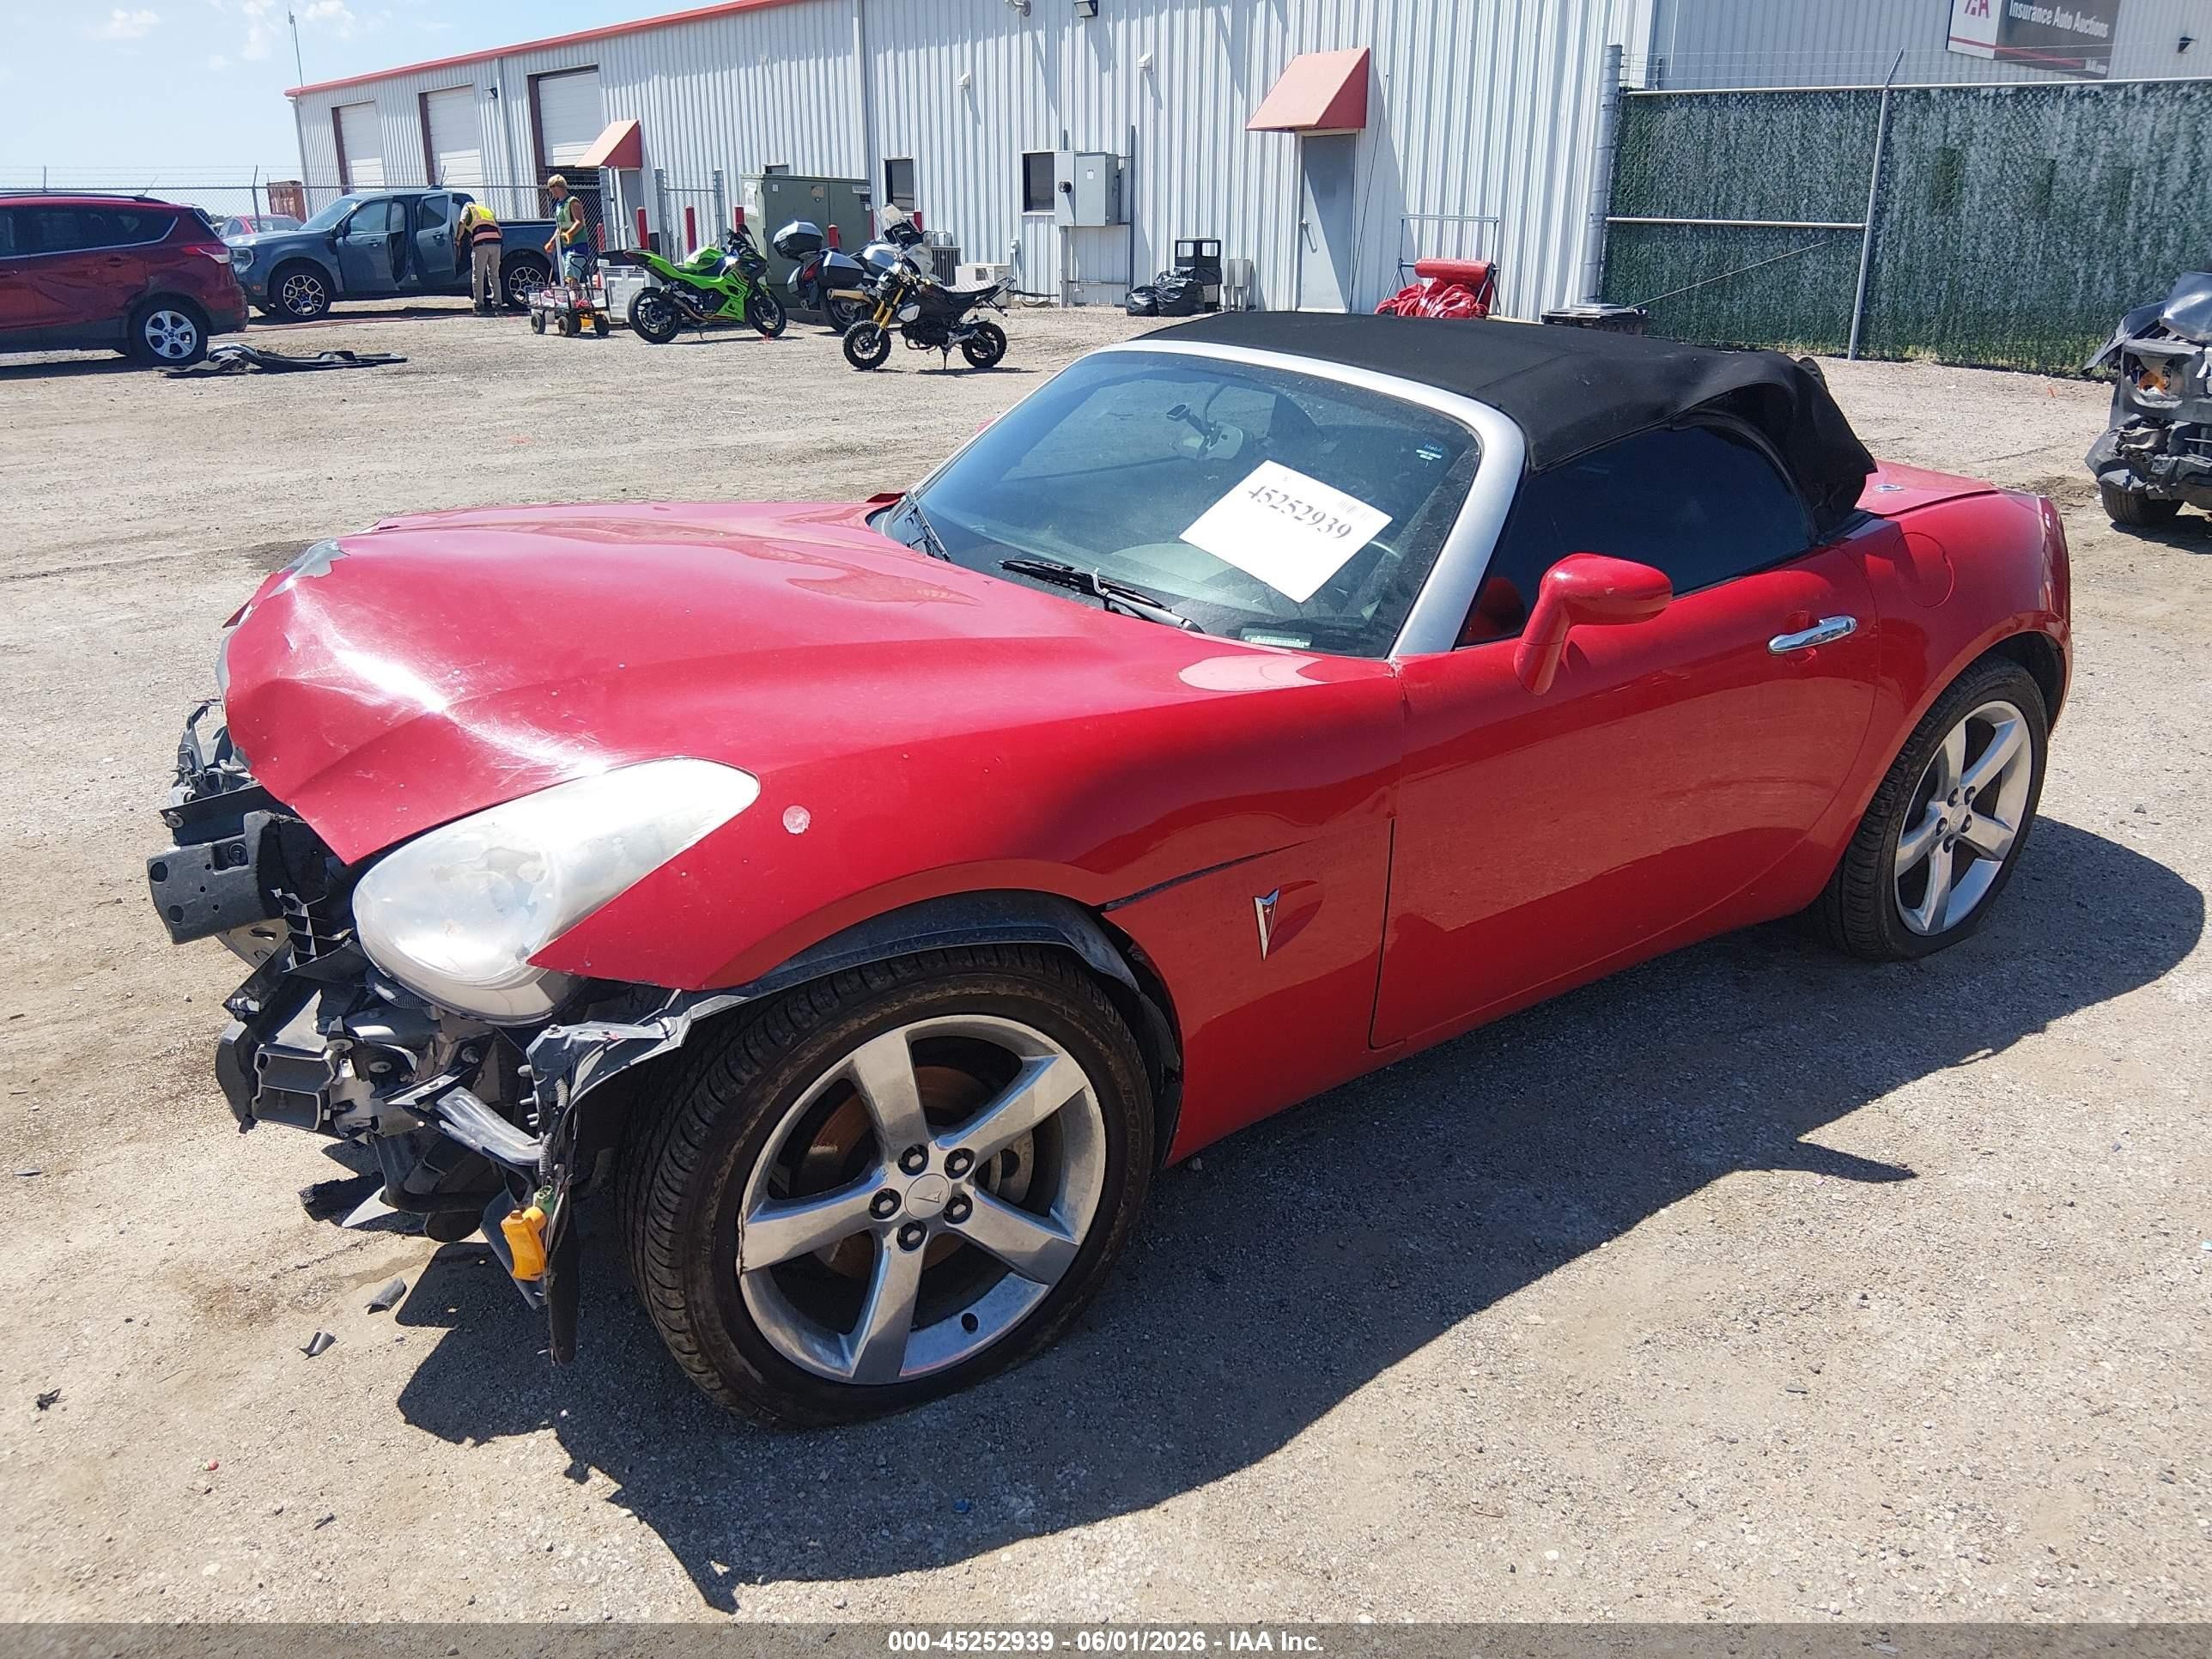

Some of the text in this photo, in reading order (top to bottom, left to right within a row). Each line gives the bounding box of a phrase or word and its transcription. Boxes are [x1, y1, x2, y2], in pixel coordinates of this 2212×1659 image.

[2009, 0, 2110, 39] Insurance Auto Auctions
[1248, 485, 1352, 538] 45252939
